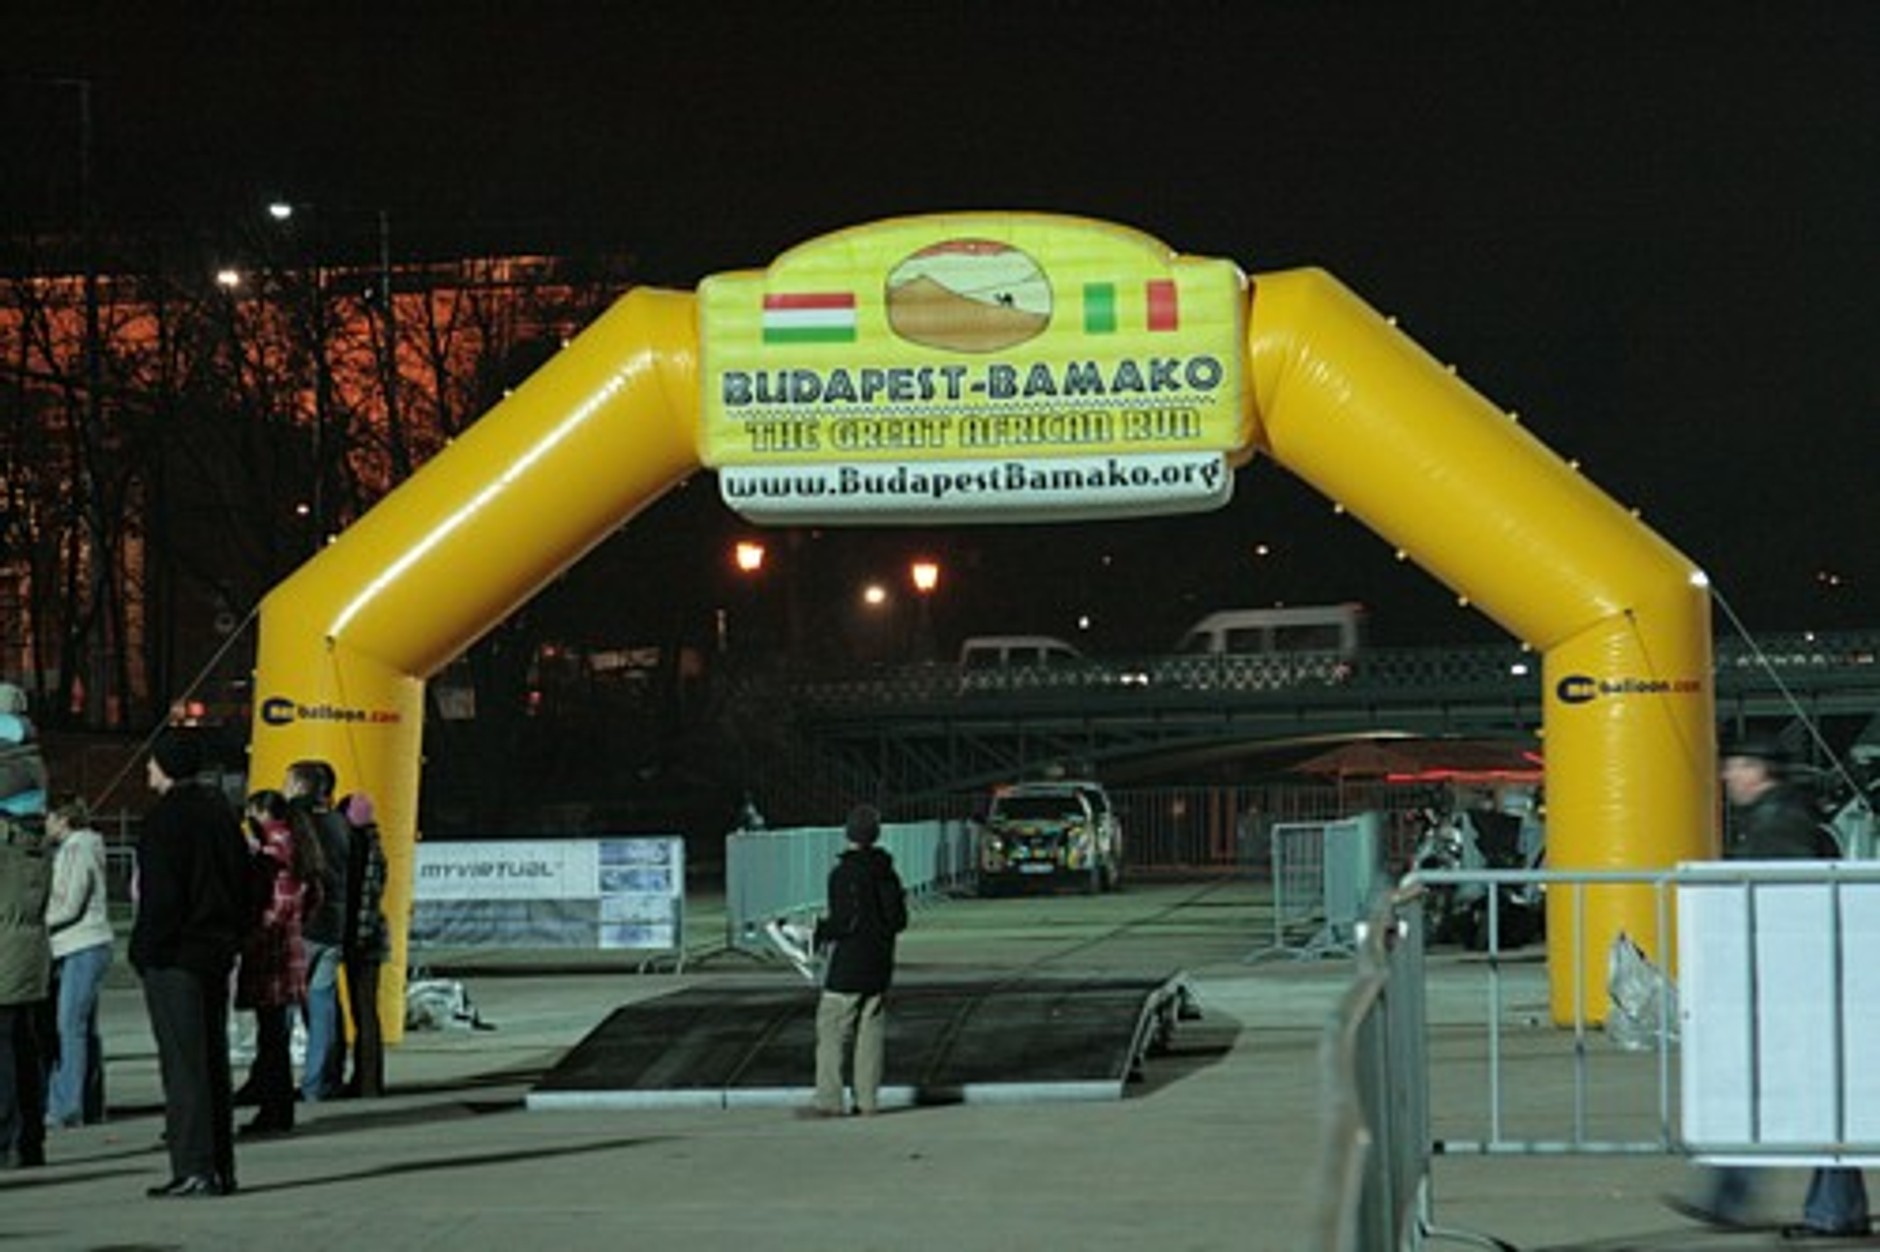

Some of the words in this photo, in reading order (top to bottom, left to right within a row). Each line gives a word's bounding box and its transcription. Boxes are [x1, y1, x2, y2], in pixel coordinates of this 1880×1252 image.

[723, 356, 1223, 405] BUDAPEST-BAMAKO
[745, 420, 820, 451] THE
[831, 417, 951, 449] GREAT
[959, 412, 1113, 447] AFRICAN
[1121, 407, 1201, 441] RUN
[726, 457, 1220, 499] www.BudapestBamako.org
